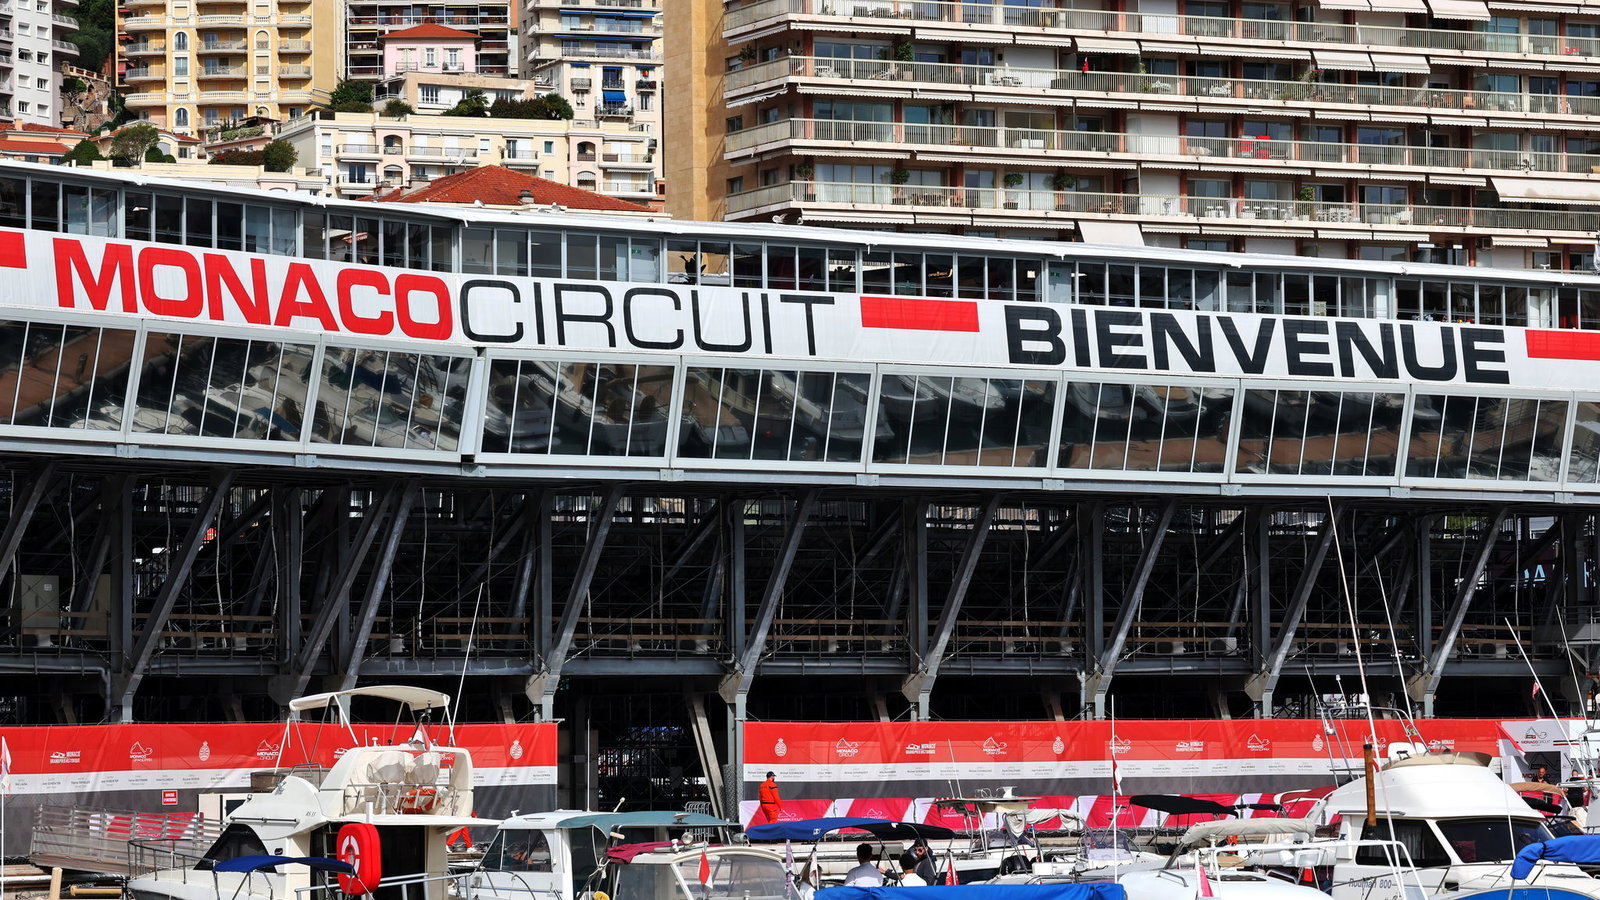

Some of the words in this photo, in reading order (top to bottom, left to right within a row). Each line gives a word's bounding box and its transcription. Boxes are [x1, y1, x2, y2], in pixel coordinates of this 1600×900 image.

[54, 238, 453, 341] MONACO
[459, 280, 835, 356] CIRCUIT
[1004, 304, 1510, 385] BIENVENUE
[1379, 879, 1393, 889] 800
